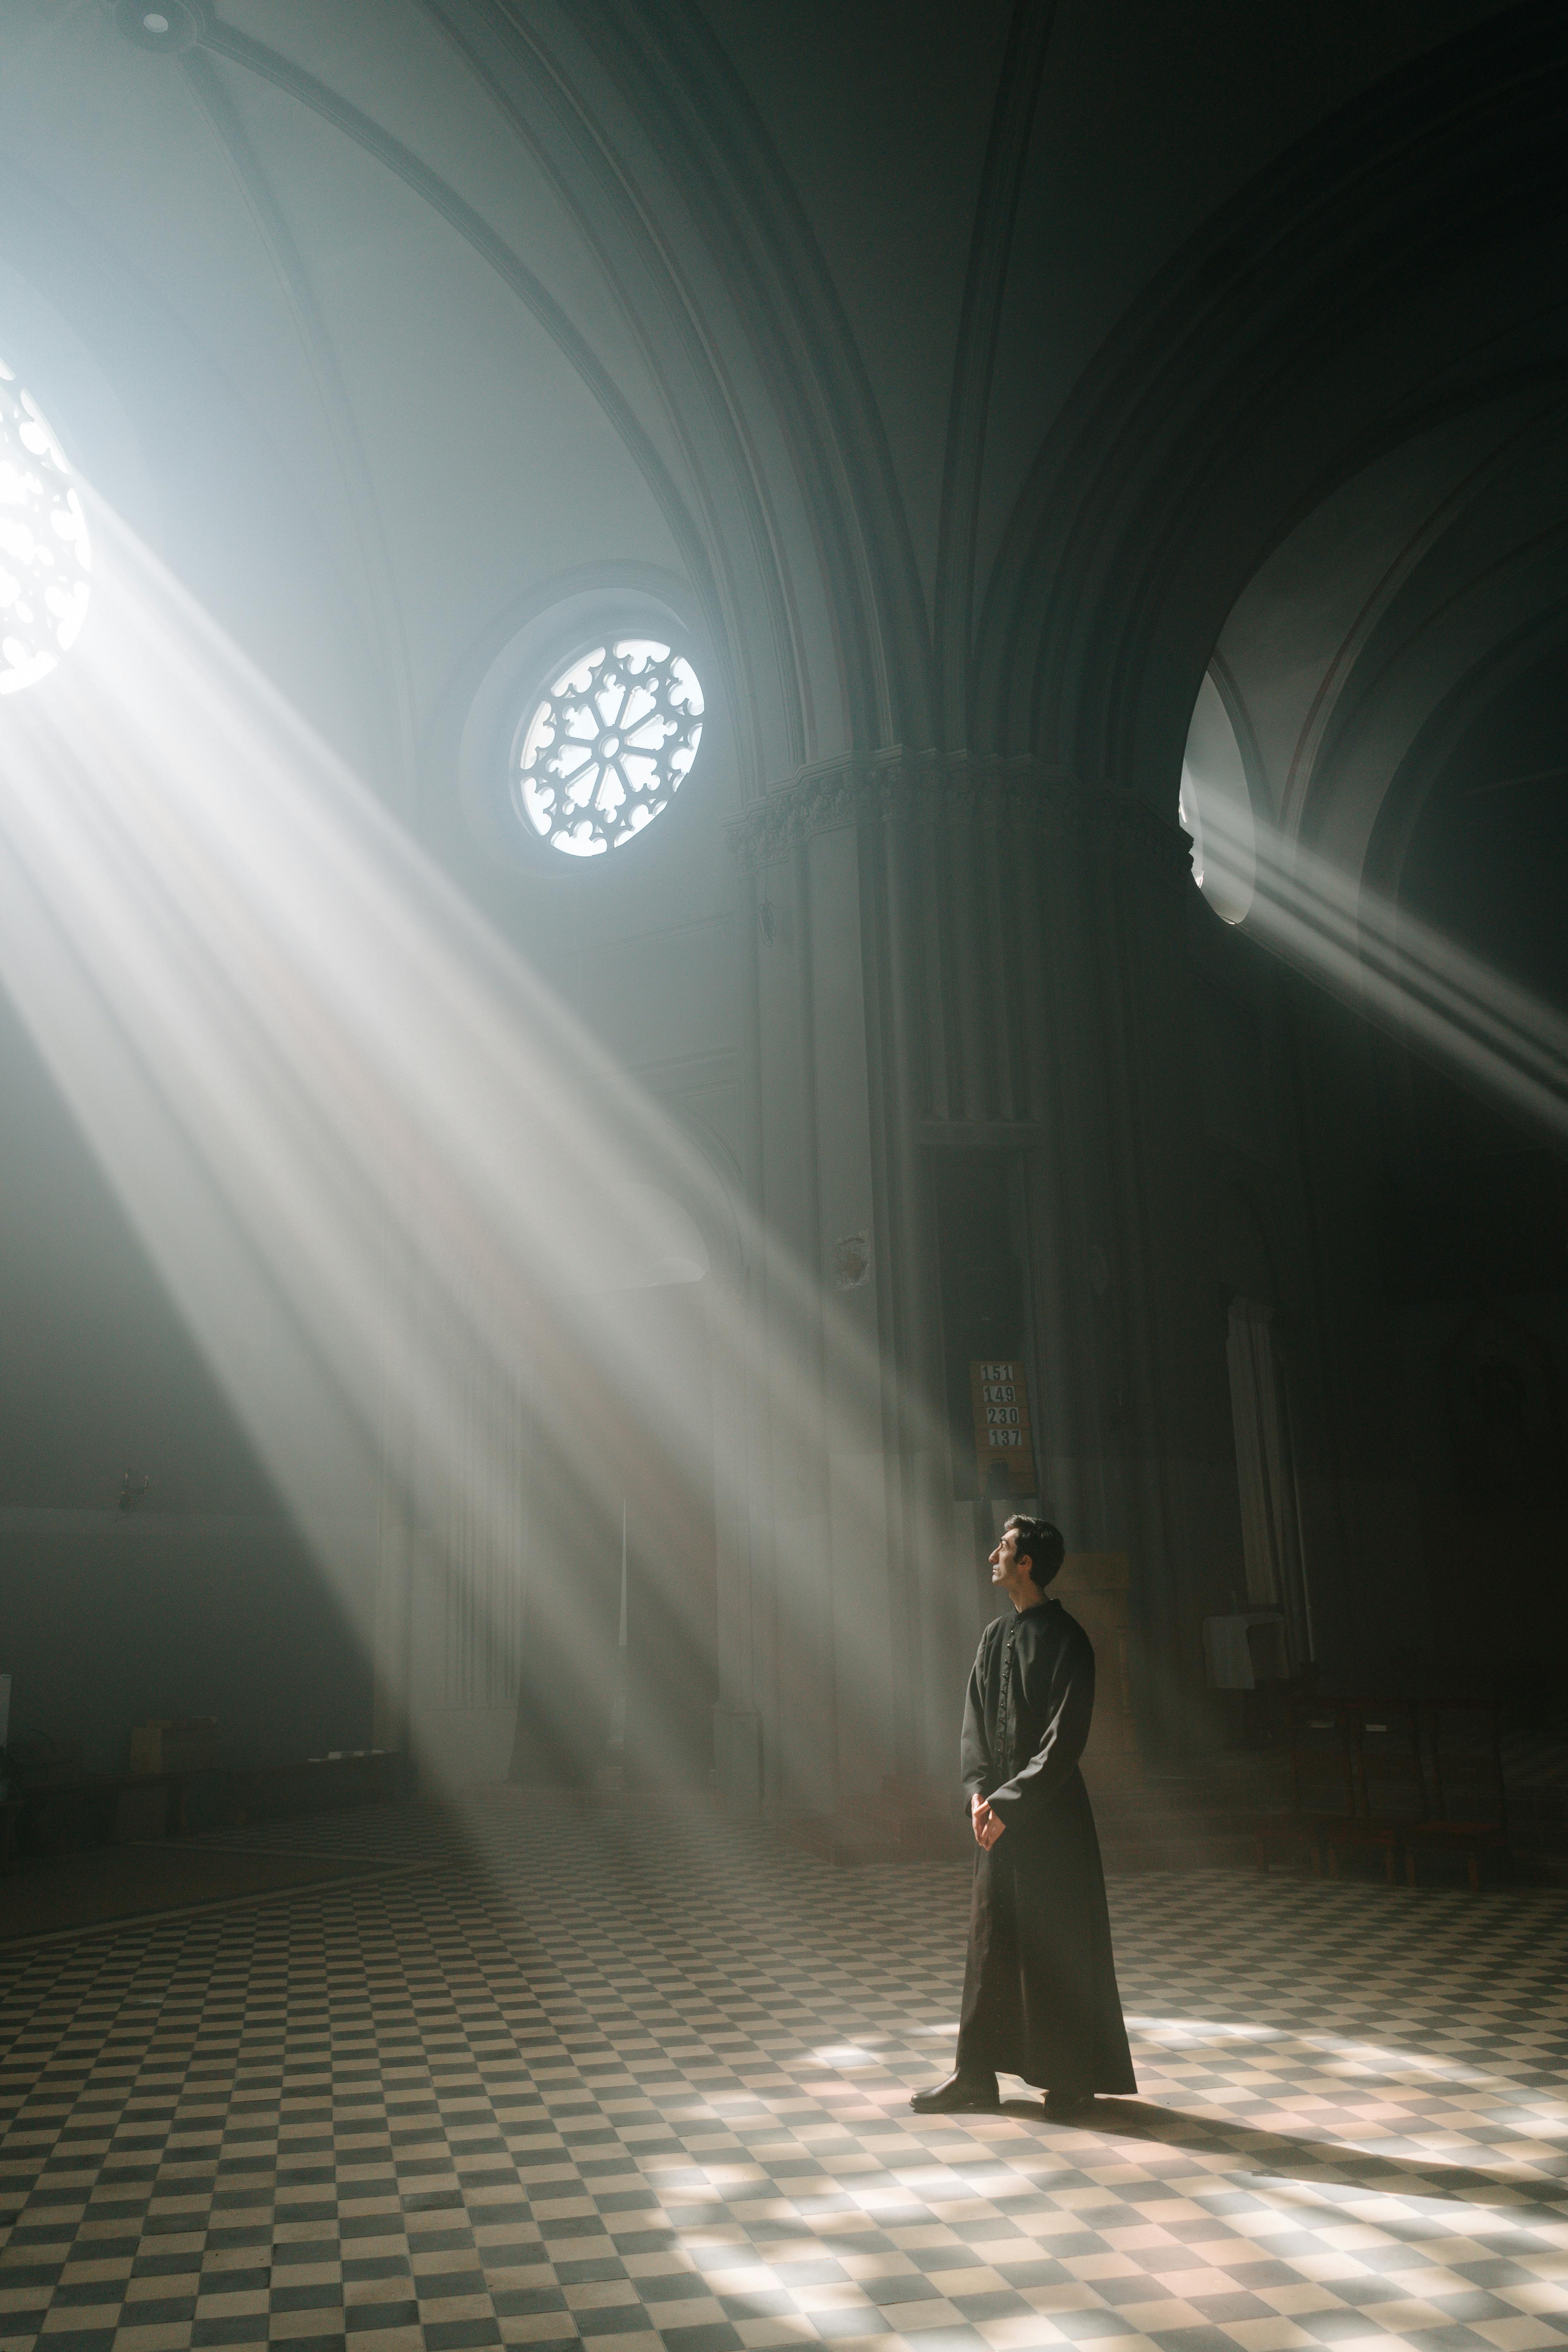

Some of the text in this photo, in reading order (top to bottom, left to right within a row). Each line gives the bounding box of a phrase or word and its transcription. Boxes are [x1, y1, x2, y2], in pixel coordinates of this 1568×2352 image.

[982, 1365, 1011, 1381] 151
[985, 1386, 1014, 1402] 149
[988, 1408, 1018, 1424] 230
[991, 1430, 1020, 1446] 137
